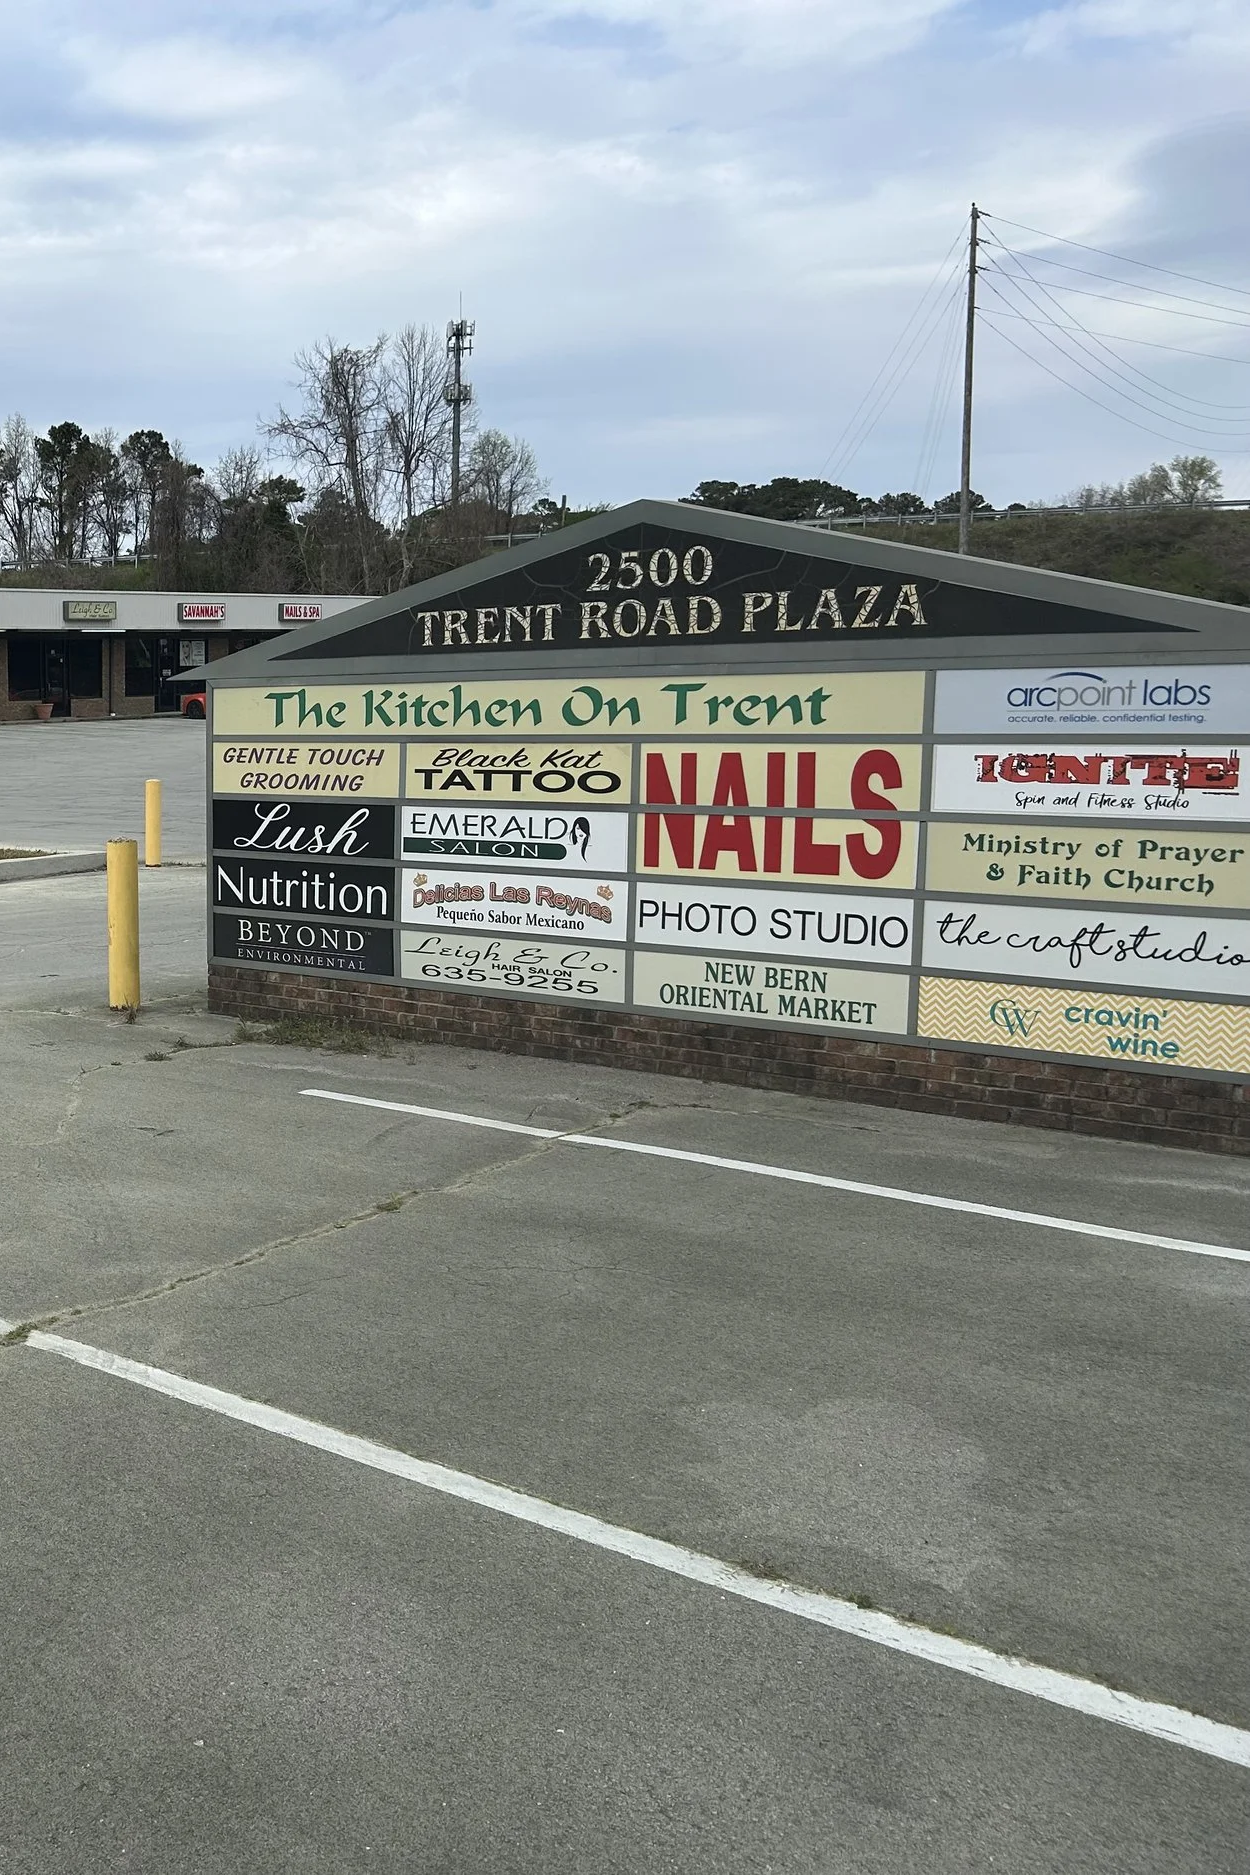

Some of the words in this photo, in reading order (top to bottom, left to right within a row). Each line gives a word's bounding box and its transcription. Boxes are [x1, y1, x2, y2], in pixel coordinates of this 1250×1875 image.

[586, 545, 714, 592] 2500
[93, 604, 102, 613] &
[184, 605, 225, 618] SAVANNAH'S
[285, 606, 301, 617] NAILS
[302, 606, 308, 617] &
[309, 606, 320, 617] SPA
[416, 603, 563, 648] TRENT
[578, 595, 723, 640] ROAD
[740, 583, 929, 633] PLAZA
[264, 688, 346, 728] The
[361, 684, 543, 728] Kitchen
[561, 685, 641, 727] On
[660, 682, 833, 726] Trent
[1007, 679, 1136, 711] arcpoint
[1142, 678, 1211, 707] labs
[1007, 714, 1057, 723] accurate.
[1059, 713, 1100, 723] reliable.
[1102, 713, 1166, 723] confidential
[1168, 713, 1207, 724] testing.
[223, 747, 299, 764] GENTLE
[308, 748, 385, 766] TOUCH
[431, 748, 531, 768] Black
[540, 749, 604, 768] Kat
[974, 751, 1240, 791] IGNITE
[240, 773, 365, 791] GROOMING
[414, 769, 622, 794] TATTOO
[643, 749, 902, 880] NAILS
[1015, 791, 1046, 810] Spin
[1052, 791, 1078, 808] and
[1087, 792, 1135, 809] Fitness
[1144, 792, 1190, 811] Studio
[233, 803, 370, 856] Lush
[410, 813, 568, 840] EMERALD
[429, 840, 539, 857] SALON
[962, 833, 1082, 860] Ministry
[1095, 839, 1124, 858] of
[1138, 839, 1244, 867] Prayer
[217, 864, 387, 915] Nutrition
[986, 863, 1005, 881] &
[1017, 864, 1091, 890] Faith
[1104, 868, 1215, 897] Church
[413, 882, 484, 908] Delicias
[489, 882, 530, 903] Las
[535, 885, 612, 924] Reynas
[436, 905, 484, 925] Pequeño
[488, 910, 522, 926] Sabor
[526, 913, 585, 931] Mexicano
[639, 899, 757, 937] PHOTO
[769, 908, 909, 948] STUDIO
[404, 937, 501, 966] Leigh
[513, 948, 549, 965] &
[560, 951, 618, 974] Co.
[936, 912, 1001, 947] the
[1006, 922, 1116, 969] craft
[1114, 925, 1250, 966] studio
[237, 948, 366, 971] ENVIRONMENTAL
[492, 963, 521, 972] HAIR
[528, 966, 572, 978] SALON
[421, 964, 599, 994] 635-9255
[704, 961, 756, 987] NEW
[764, 966, 828, 994] BERN
[659, 983, 768, 1014] ORIENTAL
[777, 994, 877, 1025] MARKET
[1064, 1005, 1168, 1031] cravin'
[1106, 1032, 1180, 1059] wine
